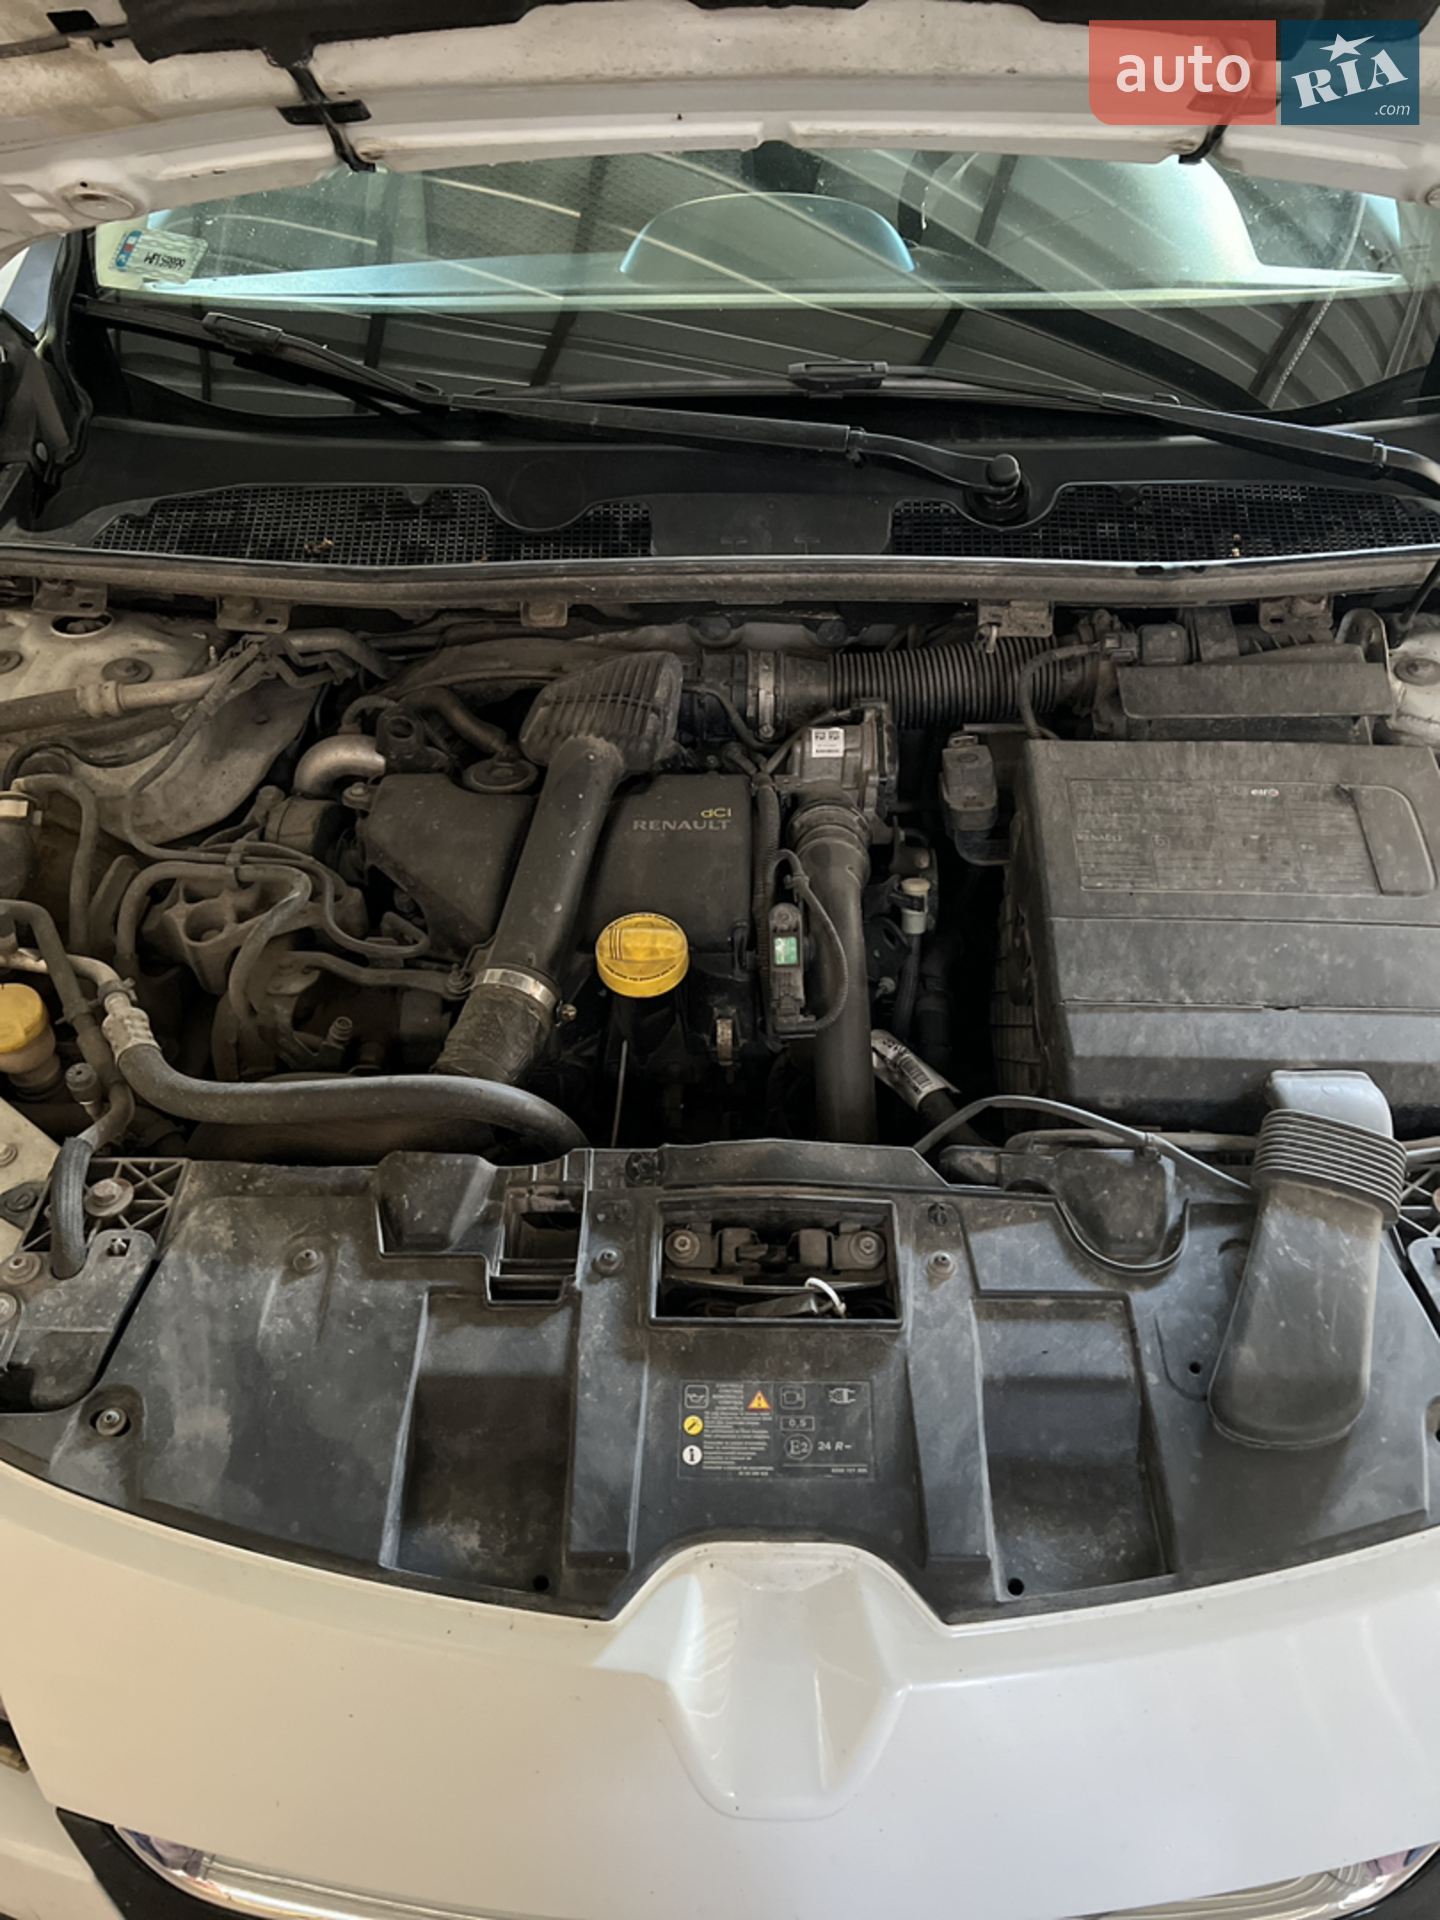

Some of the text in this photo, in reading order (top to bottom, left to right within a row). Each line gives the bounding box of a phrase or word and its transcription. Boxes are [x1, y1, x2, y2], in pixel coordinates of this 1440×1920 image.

[632, 819, 731, 832] RENAULT
[790, 1439, 808, 1455] E2
[817, 1441, 832, 1451] 24
